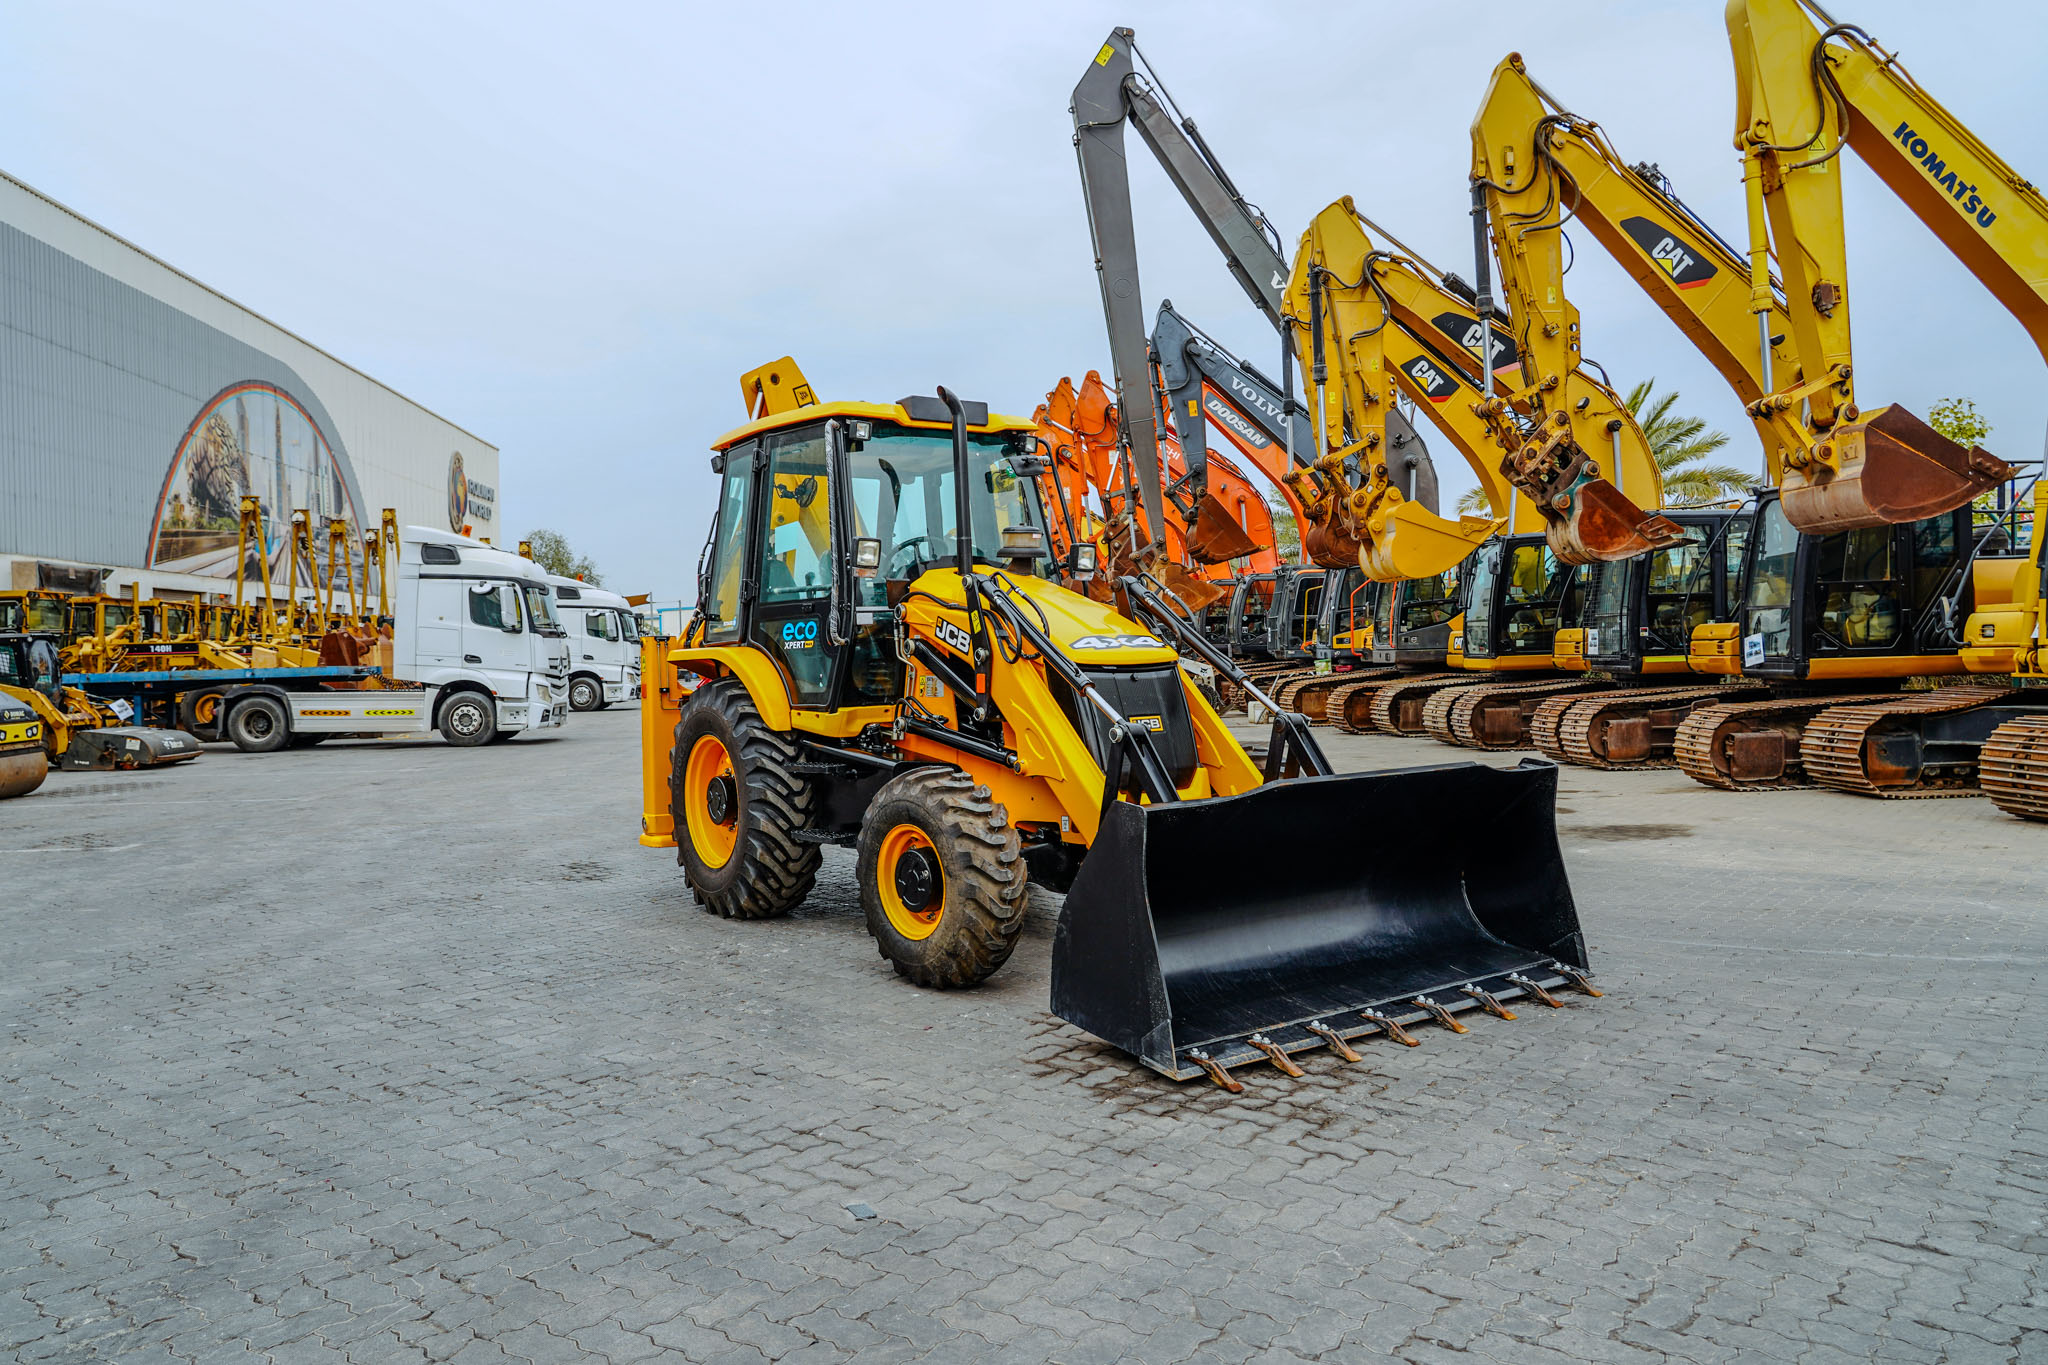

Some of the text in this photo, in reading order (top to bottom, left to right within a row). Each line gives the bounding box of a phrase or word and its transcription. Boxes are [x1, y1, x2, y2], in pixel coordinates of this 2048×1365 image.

[1893, 121, 1997, 228] KOMATSU
[1652, 237, 1694, 278] CAT
[1411, 360, 1444, 393] CAT
[1207, 400, 1266, 446] DOOSAN
[468, 500, 491, 520] WORLD
[782, 621, 817, 640] eco
[784, 641, 805, 649] XPERT
[936, 620, 971, 653] JCB
[150, 645, 172, 653] 140H
